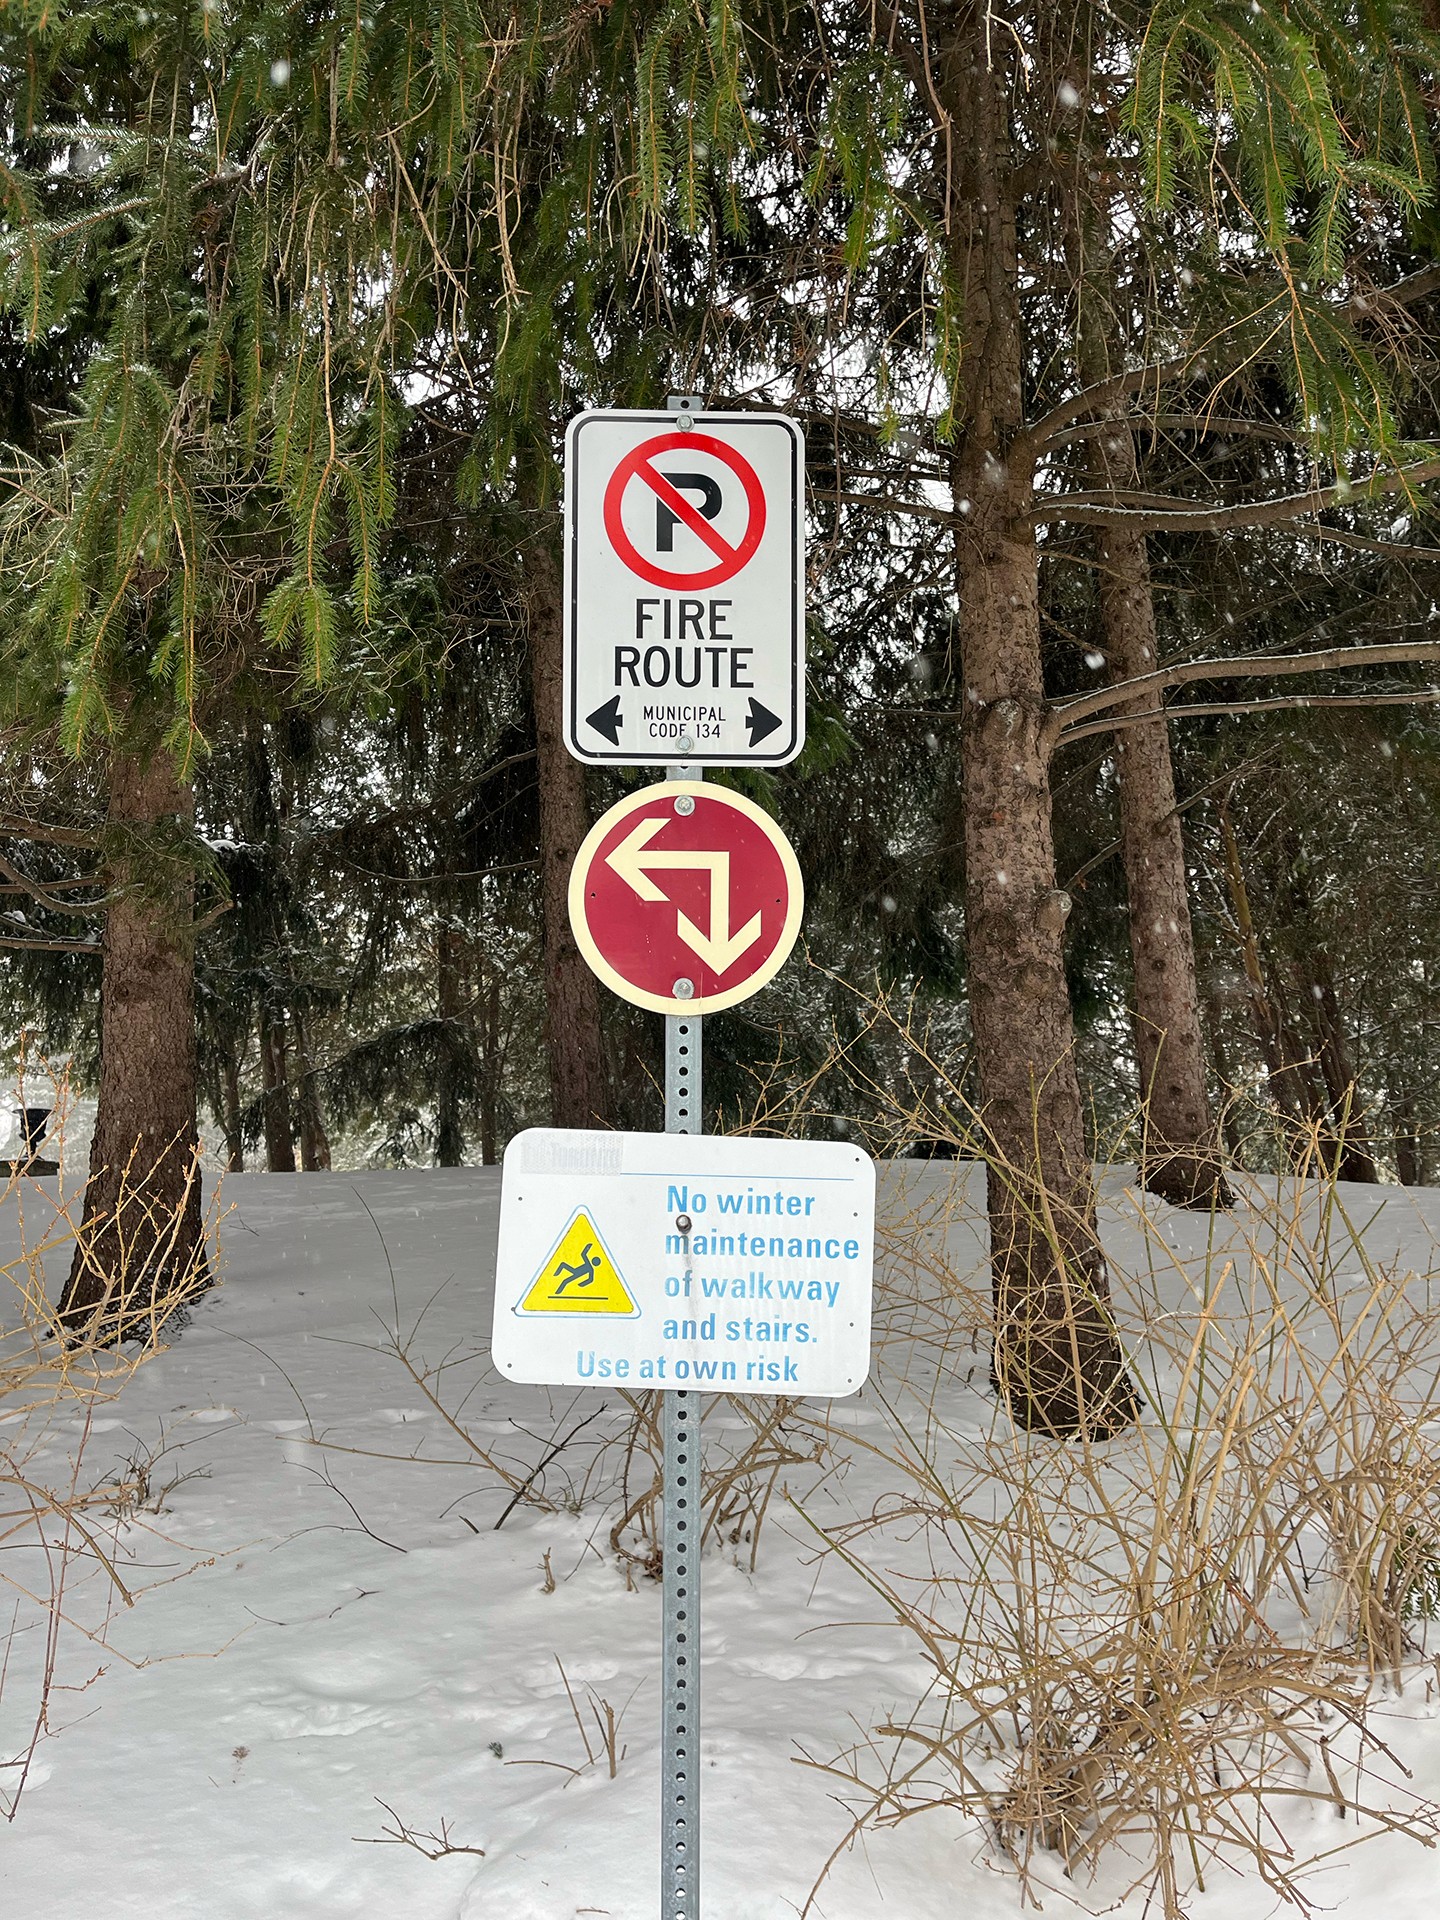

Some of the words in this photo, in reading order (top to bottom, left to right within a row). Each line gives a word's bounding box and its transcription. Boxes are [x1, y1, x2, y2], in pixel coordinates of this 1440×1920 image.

[656, 472, 723, 552] P
[636, 598, 733, 641] FIRE
[614, 645, 754, 689] ROUTE
[643, 705, 726, 722] MUNICIPAL
[649, 722, 687, 738] CODE
[696, 723, 721, 739] 134
[666, 1184, 708, 1214] No
[716, 1186, 816, 1217] winter
[665, 1228, 860, 1260] maintenance
[664, 1270, 692, 1297] of
[701, 1270, 841, 1309] walkway
[662, 1312, 717, 1341] and
[725, 1313, 818, 1344] stairs.
[577, 1350, 630, 1379] Use
[638, 1355, 667, 1379] at
[674, 1359, 737, 1381] own
[745, 1354, 799, 1383] risk
